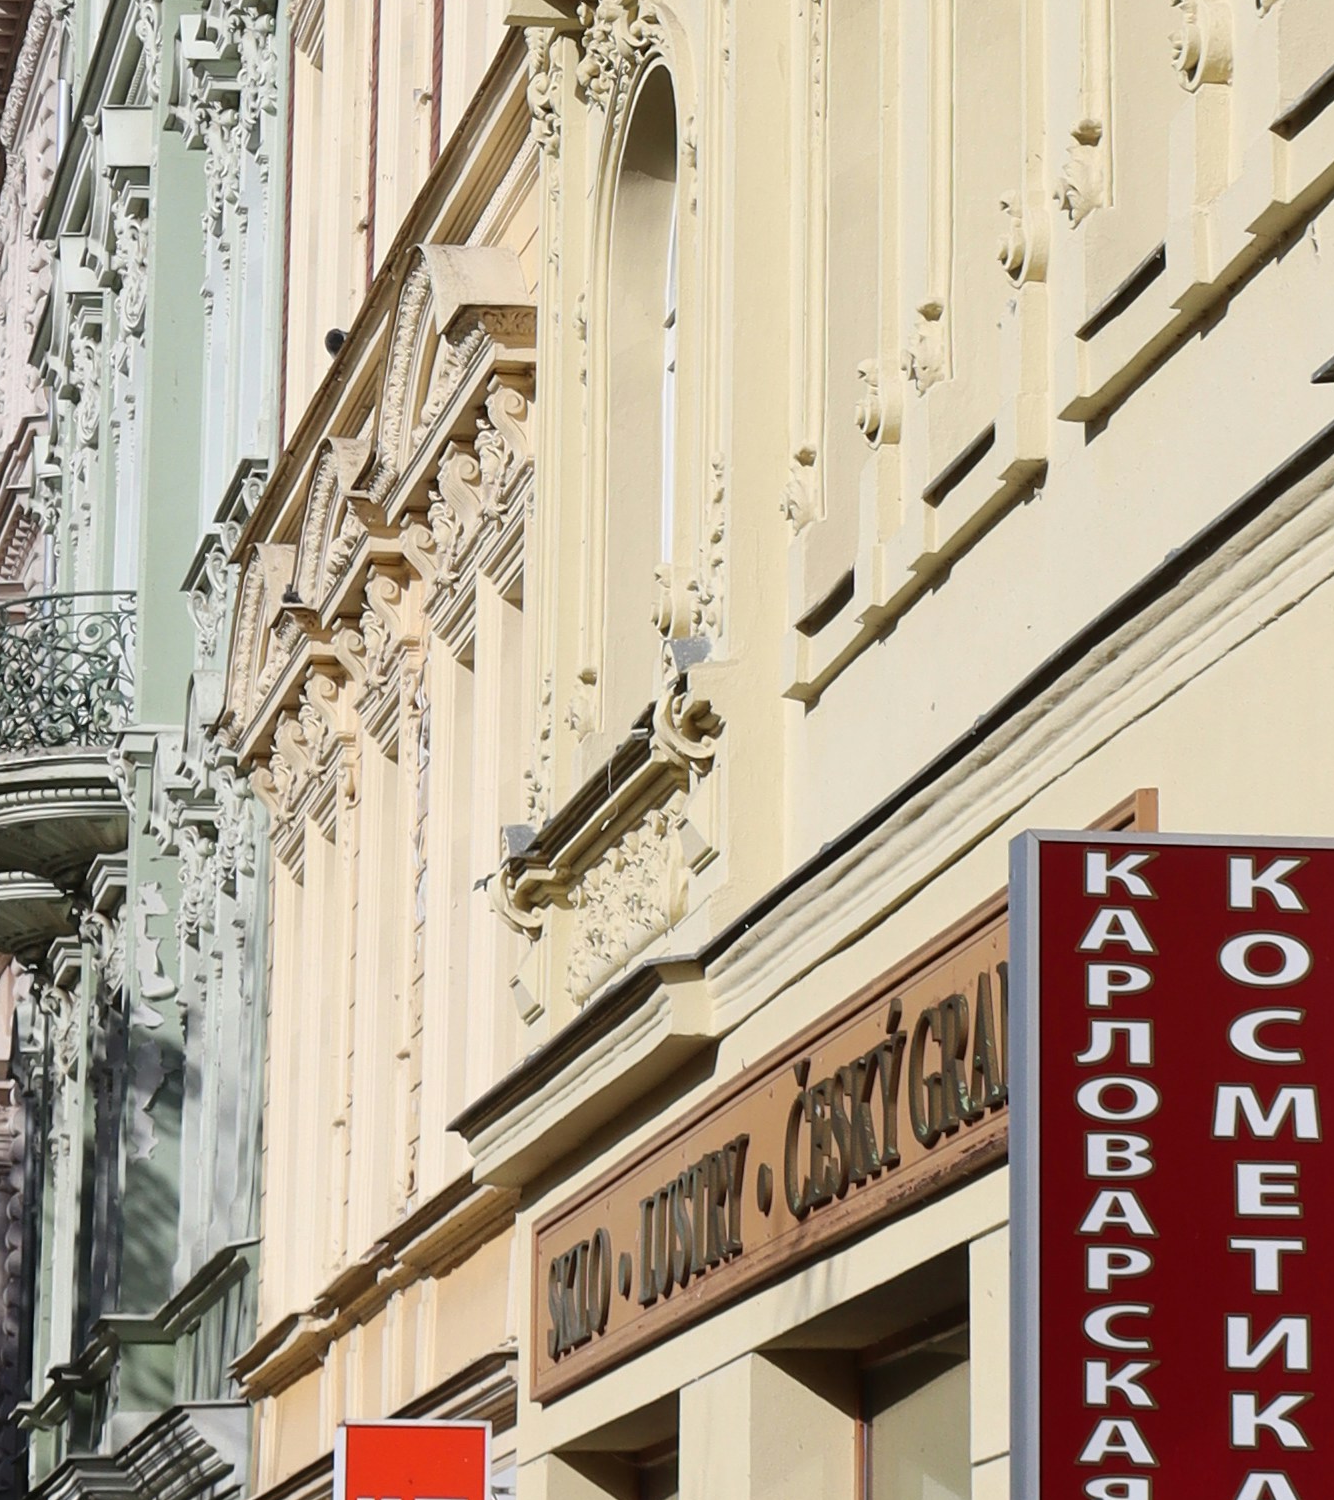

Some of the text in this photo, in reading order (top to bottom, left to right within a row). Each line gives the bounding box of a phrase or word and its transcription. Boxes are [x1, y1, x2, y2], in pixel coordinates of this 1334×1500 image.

[547, 1226, 612, 1364] SKLO
[639, 1133, 750, 1309] LUSTRY
[784, 998, 907, 1222] ČESKÝ
